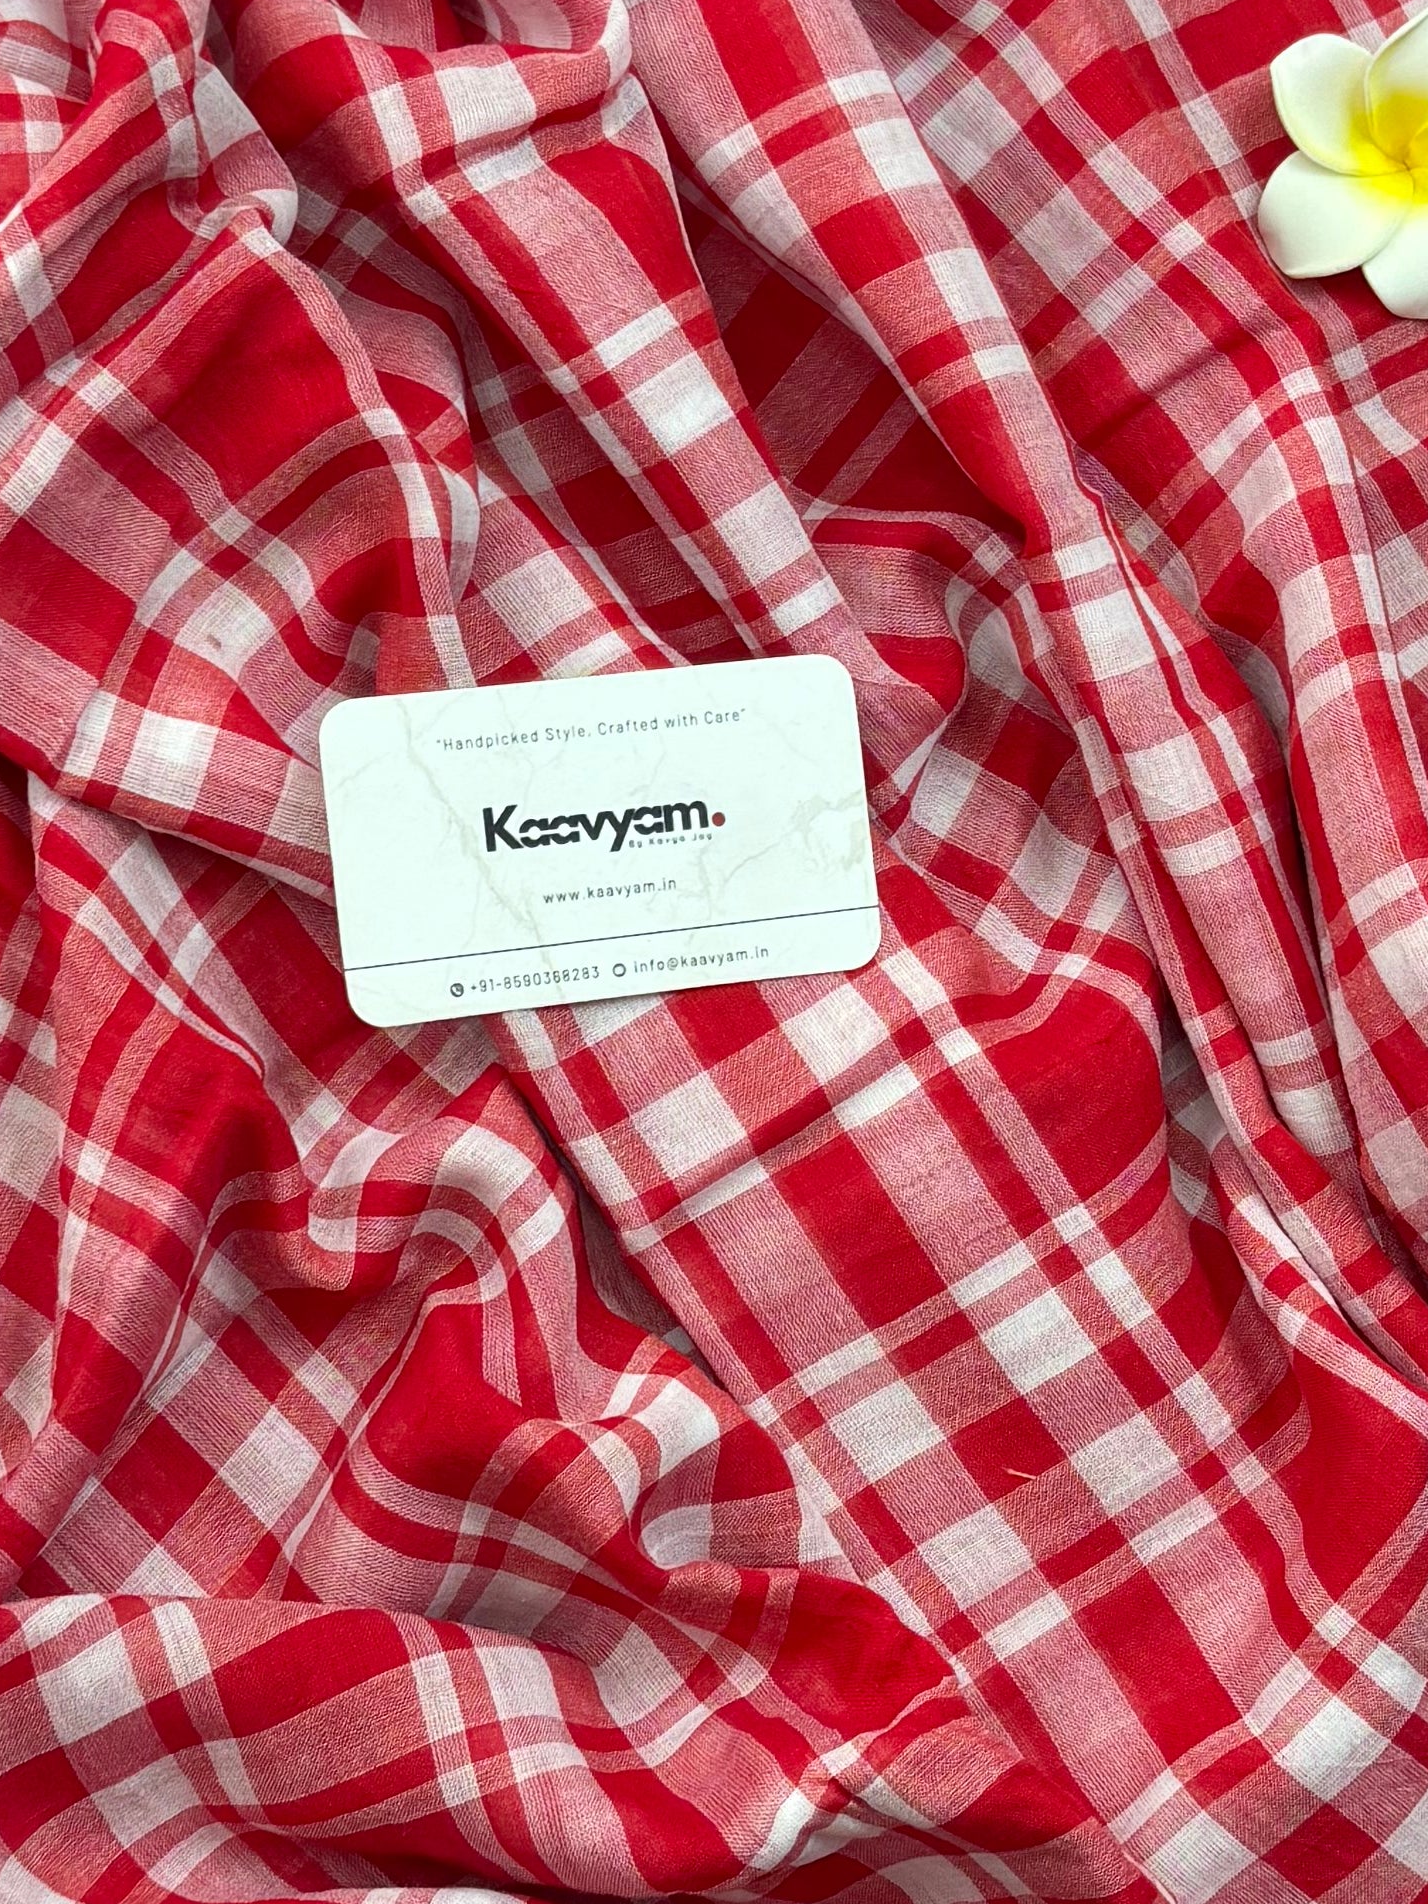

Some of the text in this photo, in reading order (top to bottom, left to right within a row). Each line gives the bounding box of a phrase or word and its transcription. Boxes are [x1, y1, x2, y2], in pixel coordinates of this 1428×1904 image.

[545, 725, 592, 743] Style,
[598, 716, 659, 736] Crafted
[664, 713, 699, 729] with
[542, 877, 677, 905] www.kaavyam.in
[633, 945, 770, 973] info@kaavyam.in
